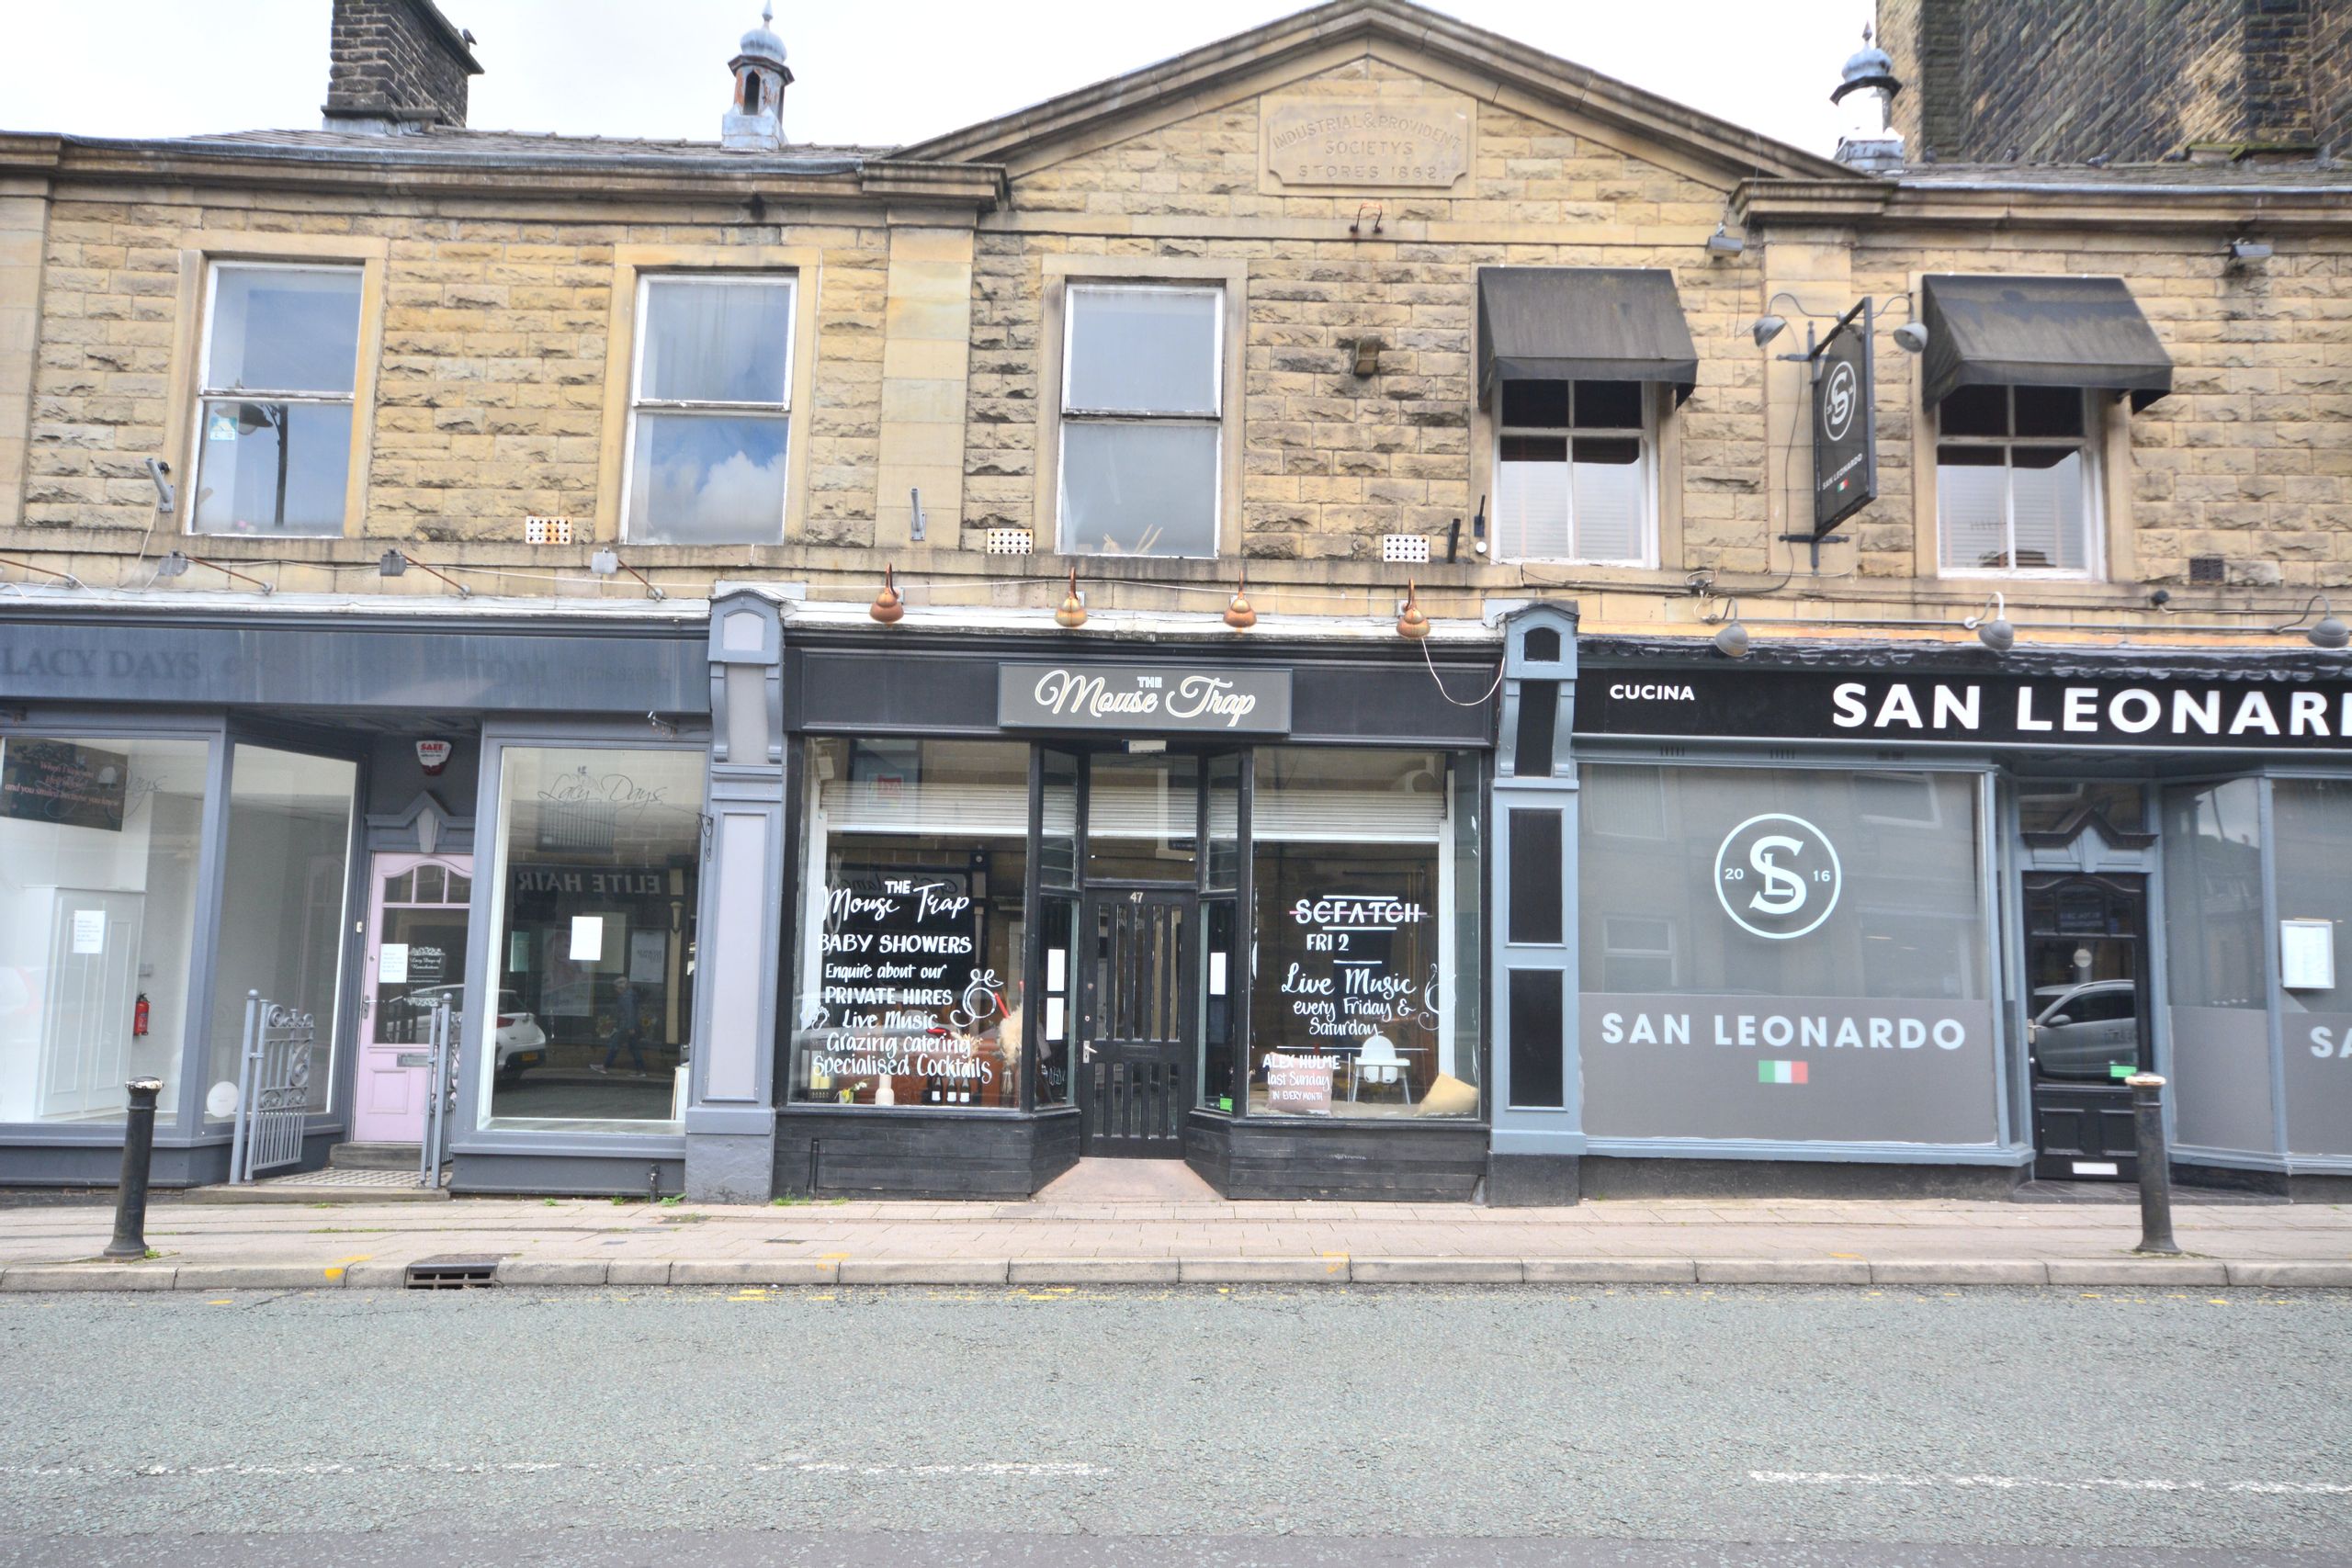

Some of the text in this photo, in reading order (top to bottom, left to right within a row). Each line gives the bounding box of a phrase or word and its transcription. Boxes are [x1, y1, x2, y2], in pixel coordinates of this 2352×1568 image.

[1272, 115, 1363, 151] INDUSTRIAL
[1378, 115, 1462, 151] PROVIDENT
[1298, 164, 1379, 179] STORES
[1833, 453, 1863, 480] LEONARDO
[2, 648, 98, 678] LACY
[109, 649, 200, 680] DAYS
[1136, 676, 1162, 688] THE
[1609, 684, 1695, 701] CUCINA
[1035, 669, 1256, 728] Mouse Trap
[1832, 682, 2352, 737] SAN LEONAR
[601, 773, 668, 818] Days
[1724, 868, 1744, 881] 20
[1813, 869, 1831, 882] 16
[885, 879, 911, 895] THE
[1130, 891, 1144, 904] 47
[820, 883, 970, 923] Mouse Trap
[818, 933, 973, 954] BABY SHOWERS
[1306, 933, 1350, 952] FRI 2
[825, 961, 948, 983] Enquire about our
[1281, 962, 1418, 1000] Live Music
[824, 986, 954, 1006] PRIVATE HIRES
[842, 1009, 940, 1030] Live Music
[1293, 999, 1336, 1022] every
[1342, 996, 1393, 1023] Friday
[1308, 1016, 1385, 1036] Saturday
[1601, 1012, 1966, 1051] SAN LEONARDO
[826, 1032, 972, 1059] Grazing catering
[812, 1053, 993, 1084] Specialised Cocktails
[1262, 1054, 1341, 1070] ALEX HULME
[1267, 1070, 1330, 1091] last Sunday
